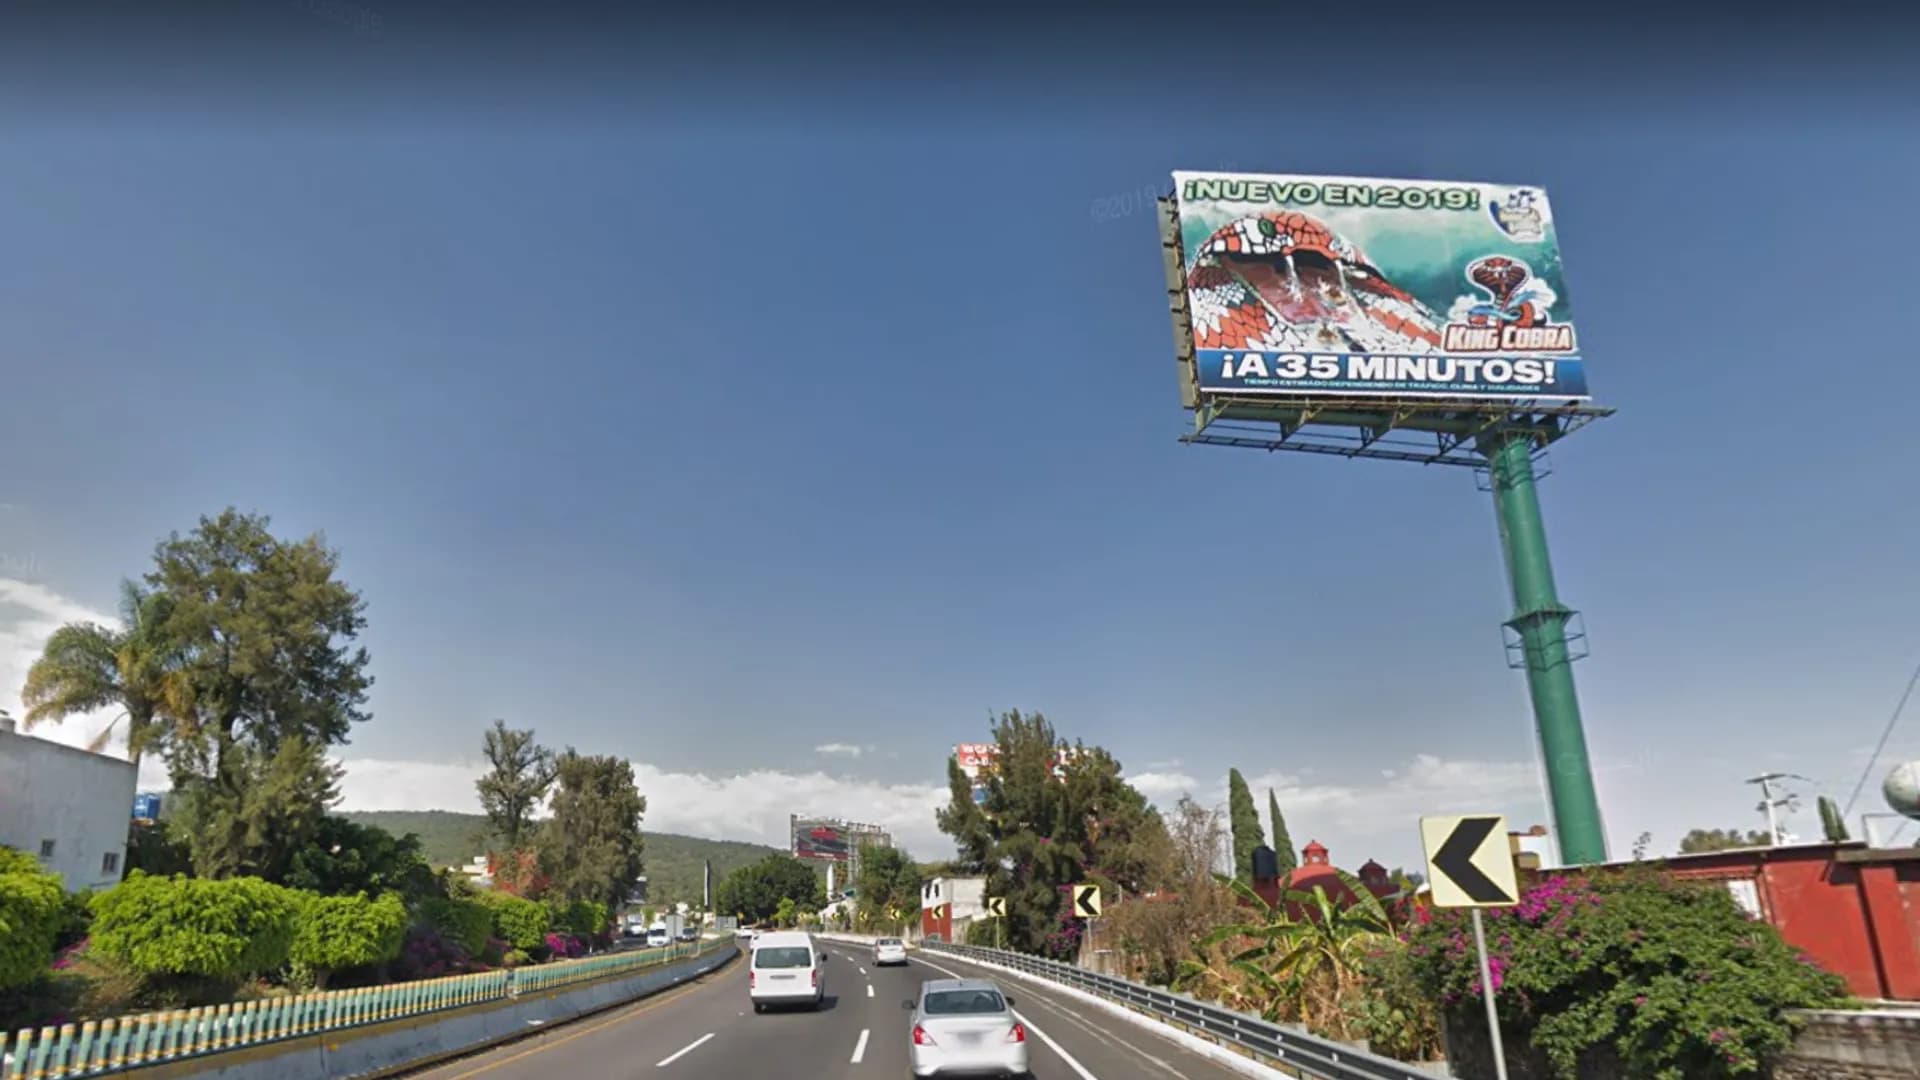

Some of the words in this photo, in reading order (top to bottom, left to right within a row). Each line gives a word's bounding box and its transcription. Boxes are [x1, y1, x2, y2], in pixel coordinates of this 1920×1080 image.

[1184, 180, 1319, 205] ¡NUEVO
[1323, 183, 1372, 208] EN
[1376, 185, 1480, 210] 2019!
[1501, 325, 1572, 351] COBRA
[1222, 353, 1268, 378] ¡A
[1275, 354, 1340, 379] 35
[1347, 356, 1555, 384] MINUTOS!
